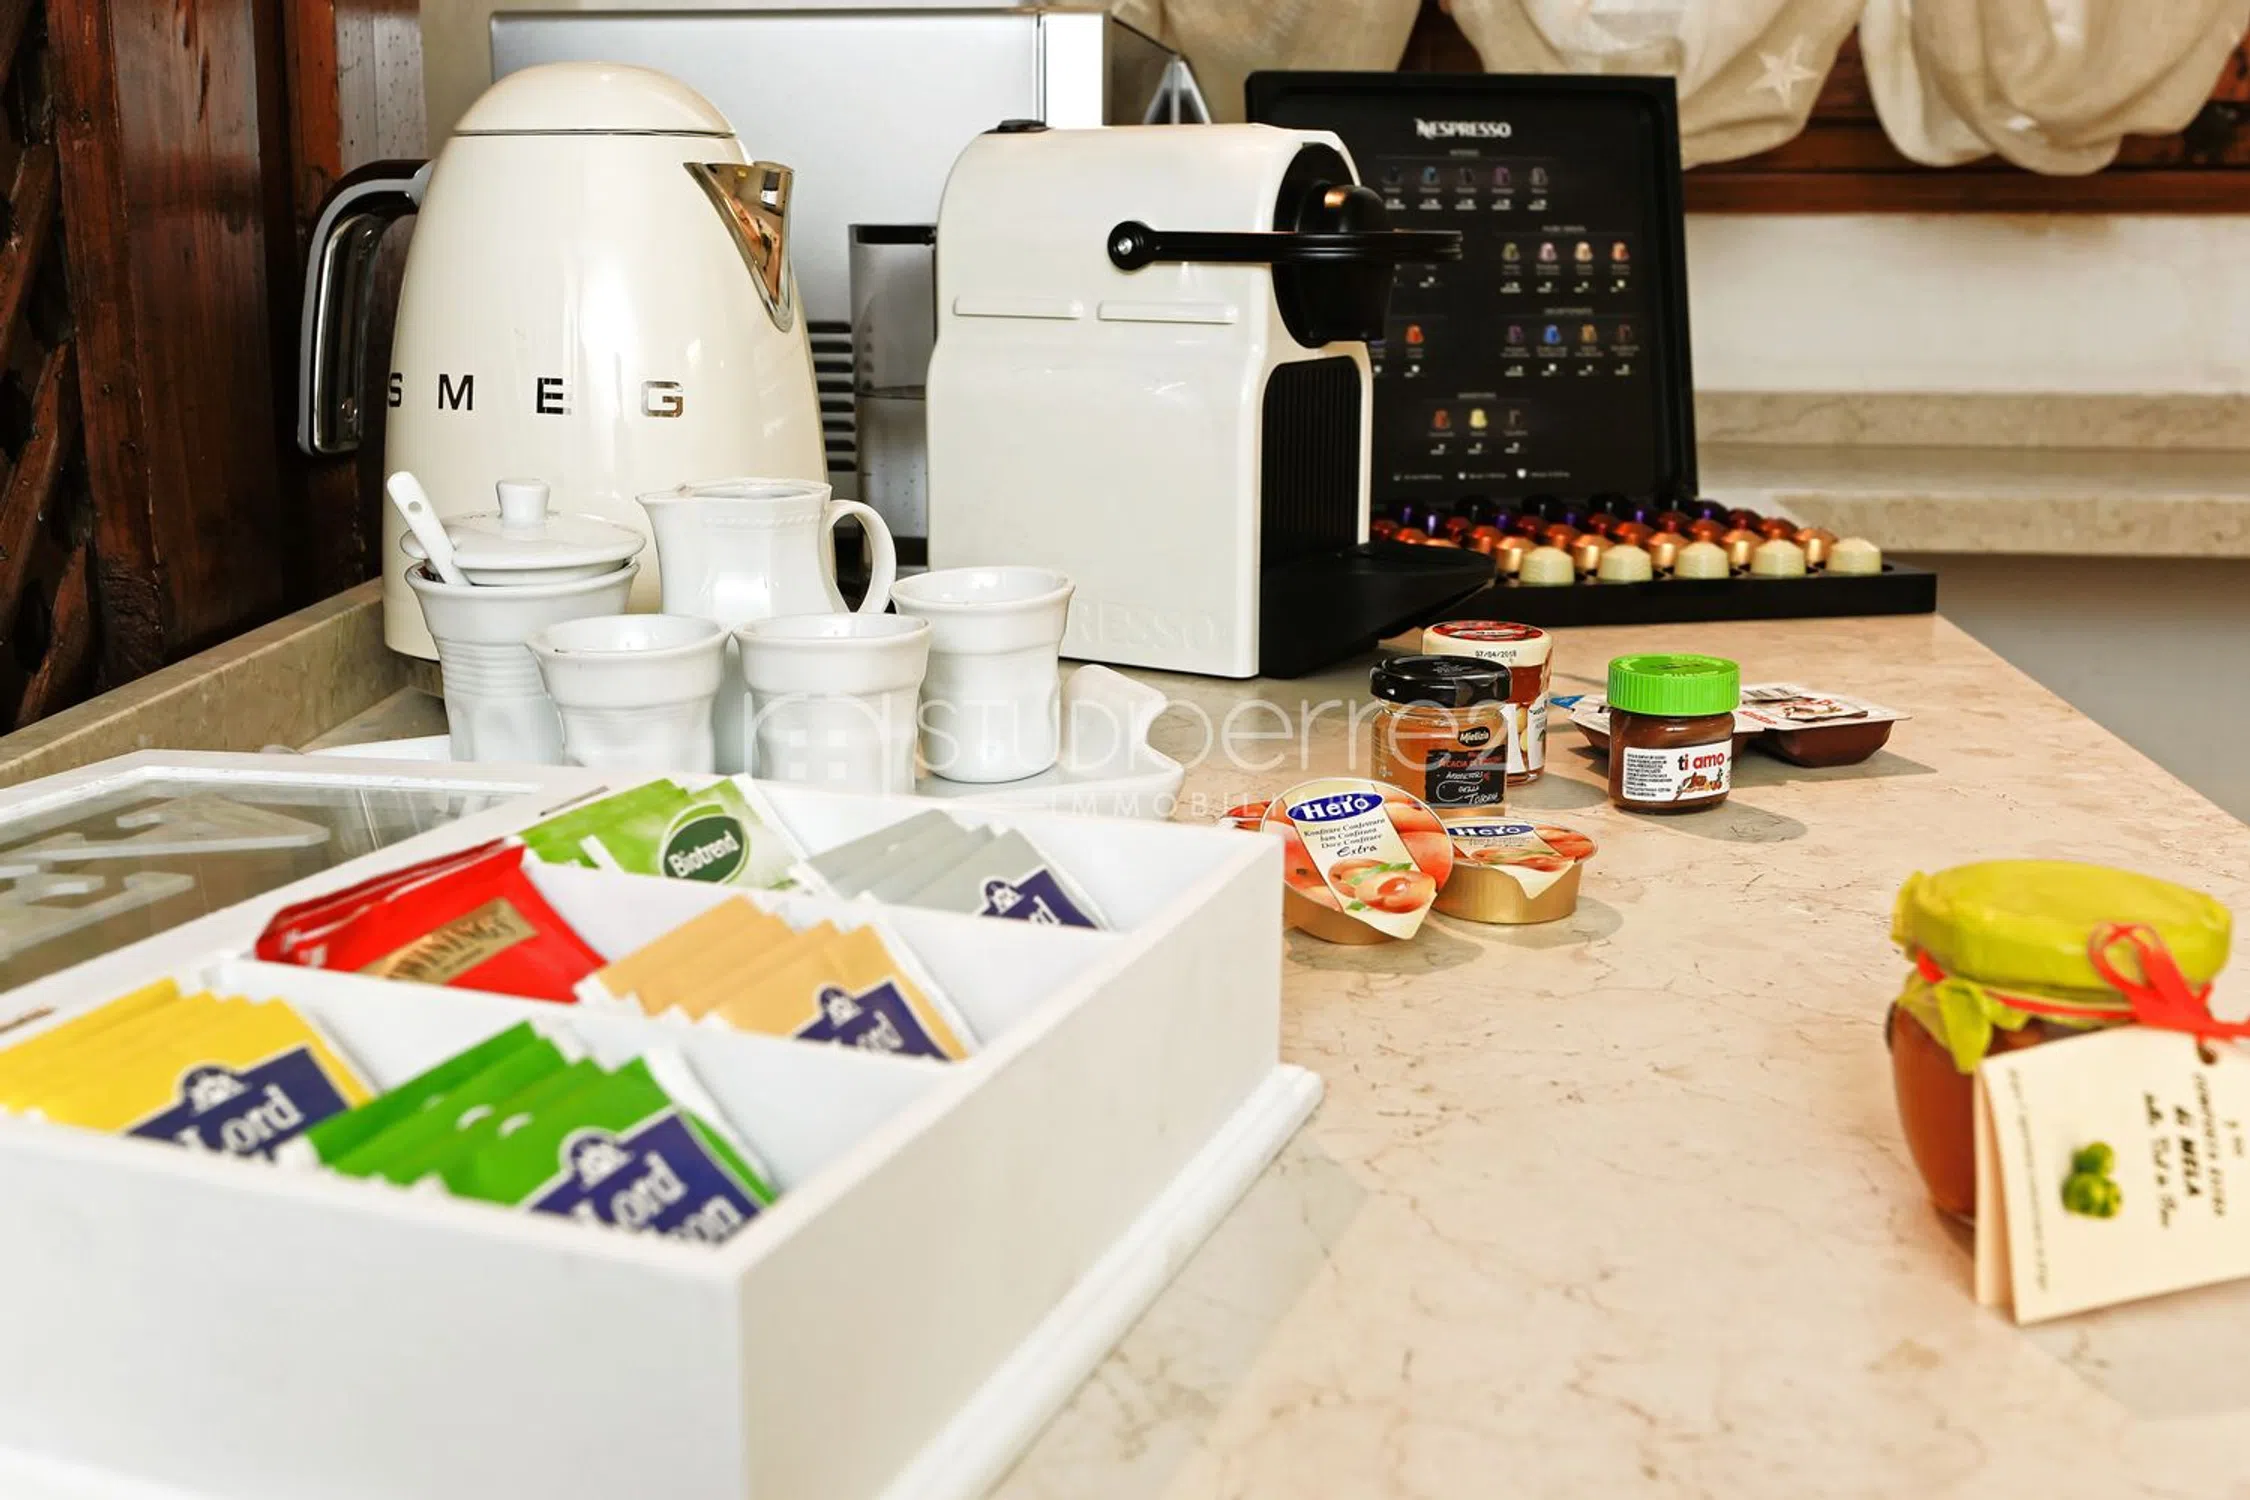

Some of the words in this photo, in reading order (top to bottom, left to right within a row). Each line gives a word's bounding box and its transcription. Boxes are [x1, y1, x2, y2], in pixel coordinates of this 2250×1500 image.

[1413, 117, 1512, 140] NESPRESSO
[388, 372, 683, 418] SMEG
[1677, 753, 1689, 771] ti
[1693, 752, 1725, 769] amo
[1300, 795, 1370, 821] Hero
[1456, 826, 1521, 836] Hero
[667, 830, 741, 879] Biotrend
[1337, 845, 1377, 858] Extra
